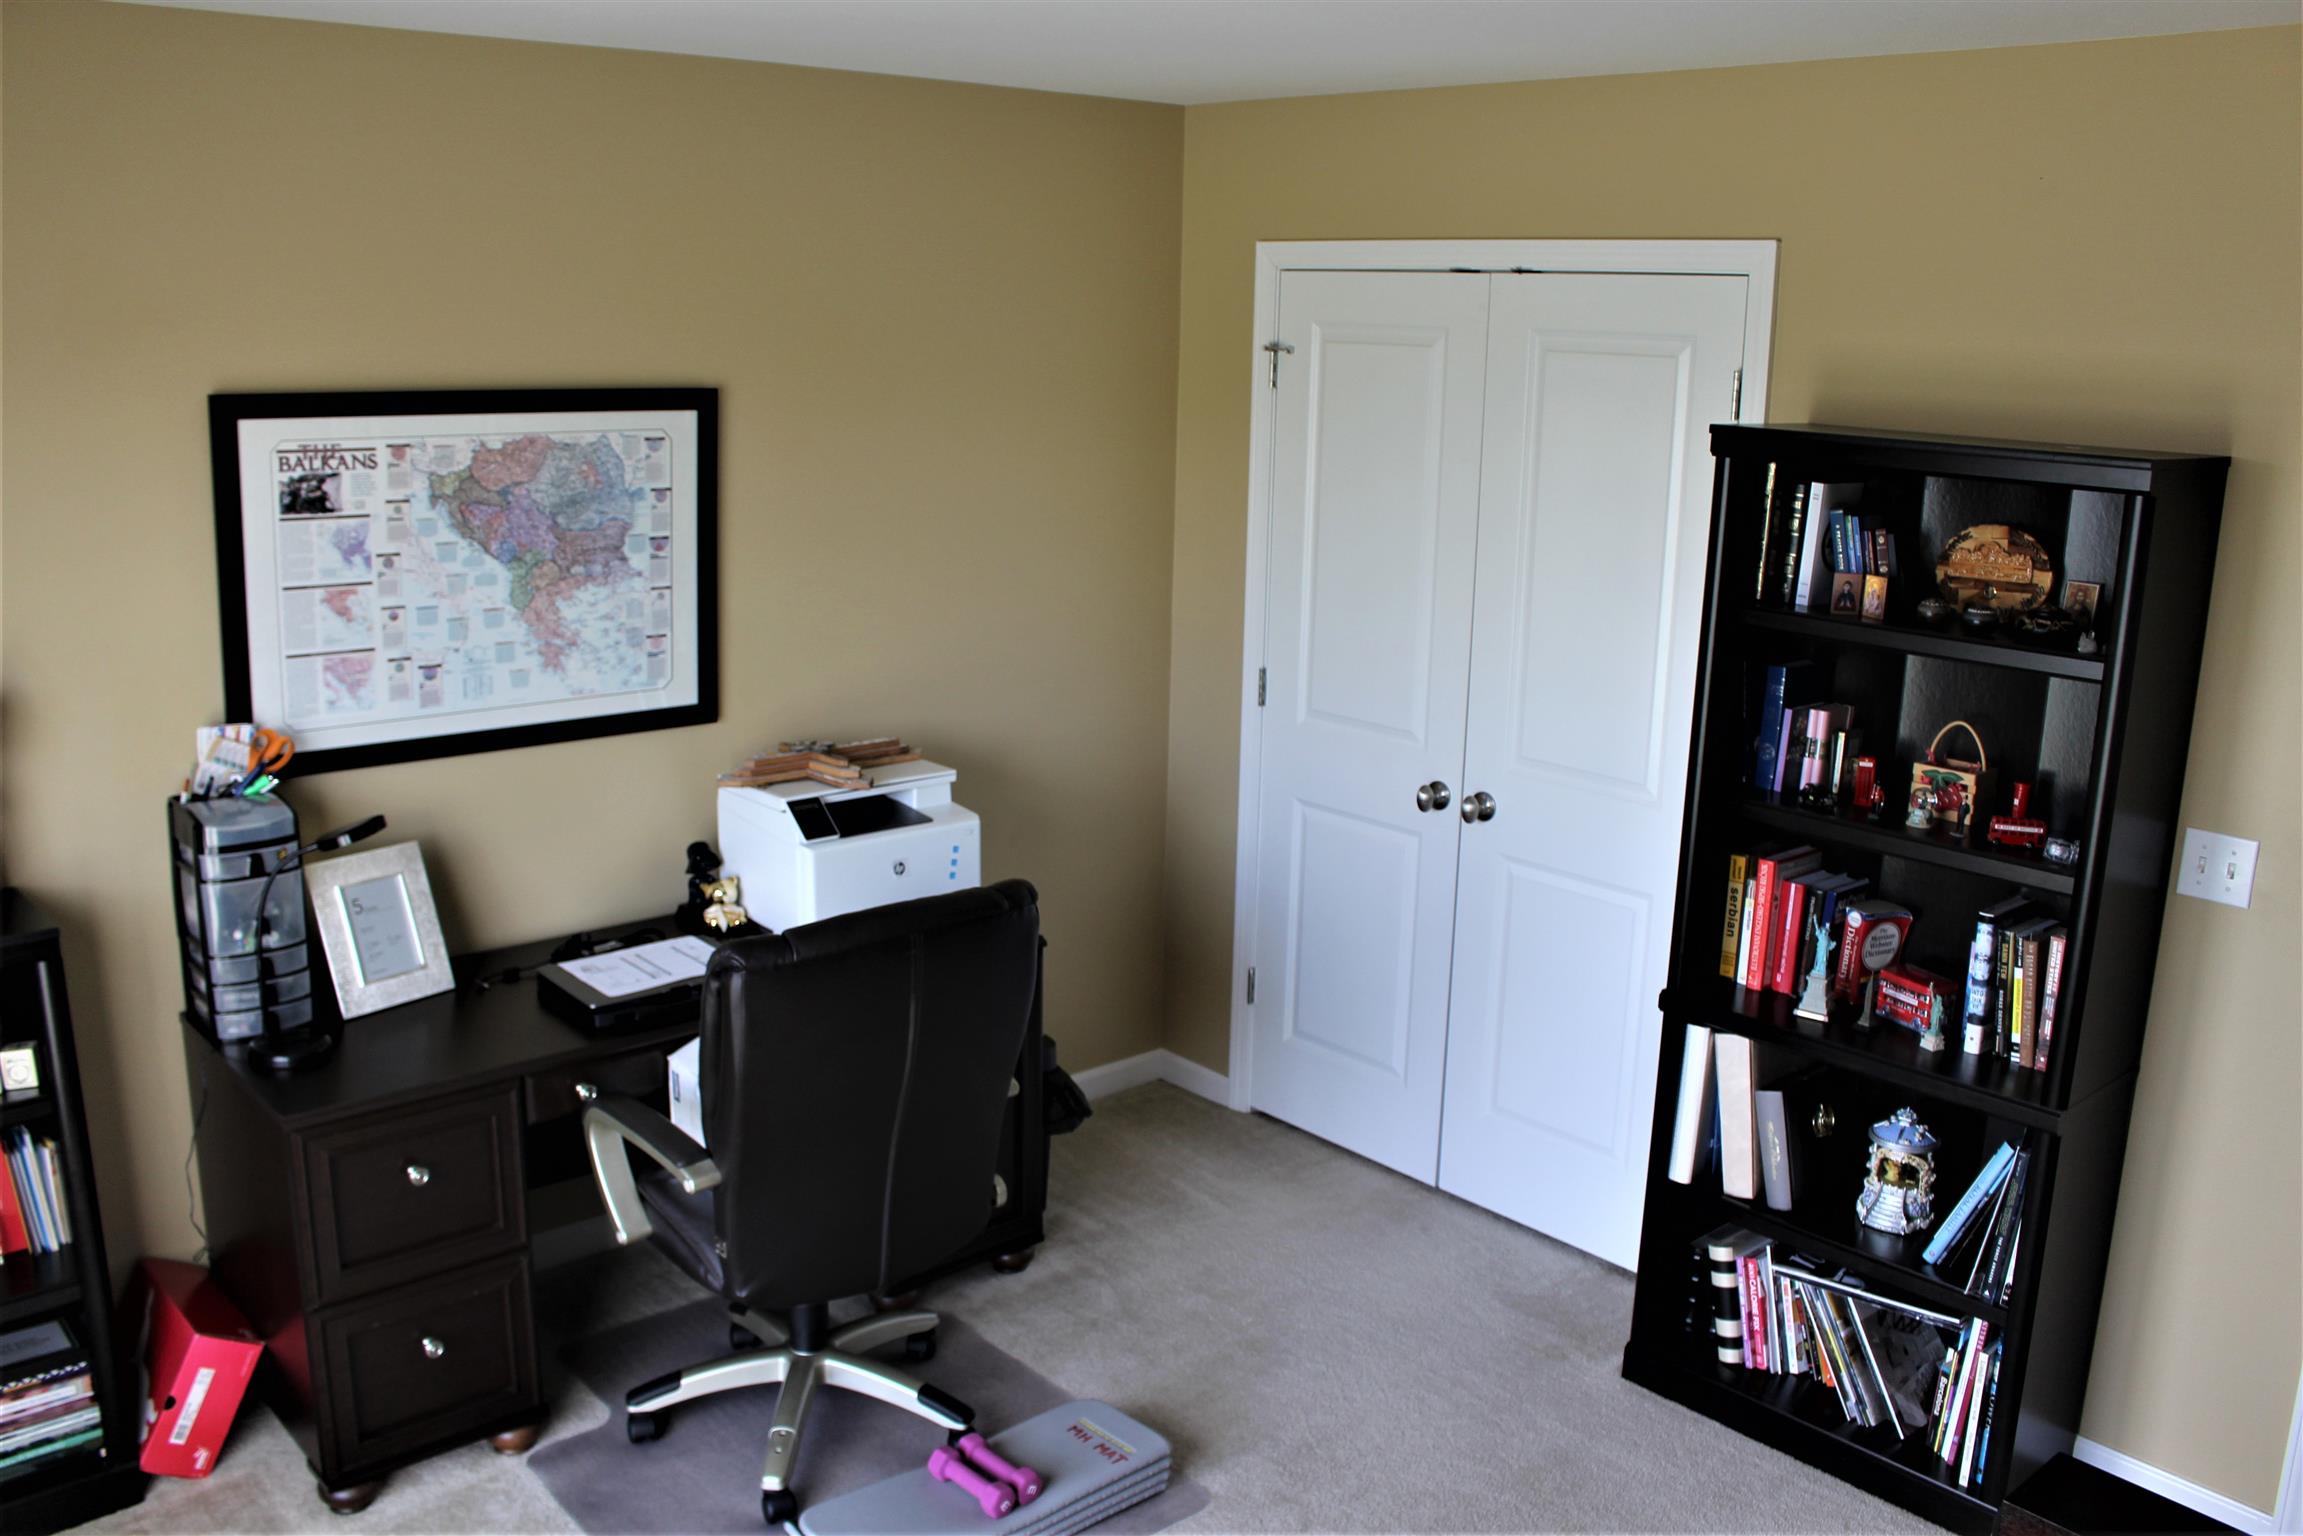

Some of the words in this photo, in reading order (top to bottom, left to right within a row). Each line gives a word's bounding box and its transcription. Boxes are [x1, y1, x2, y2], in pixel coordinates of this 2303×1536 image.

[278, 453, 378, 473] BALKANS
[297, 443, 342, 461] THE
[1726, 887, 1739, 938] serbian
[1839, 926, 1856, 978] Dictionary
[1749, 1280, 1759, 1315] CALORIE
[1933, 1375, 1948, 1416] Barcelona
